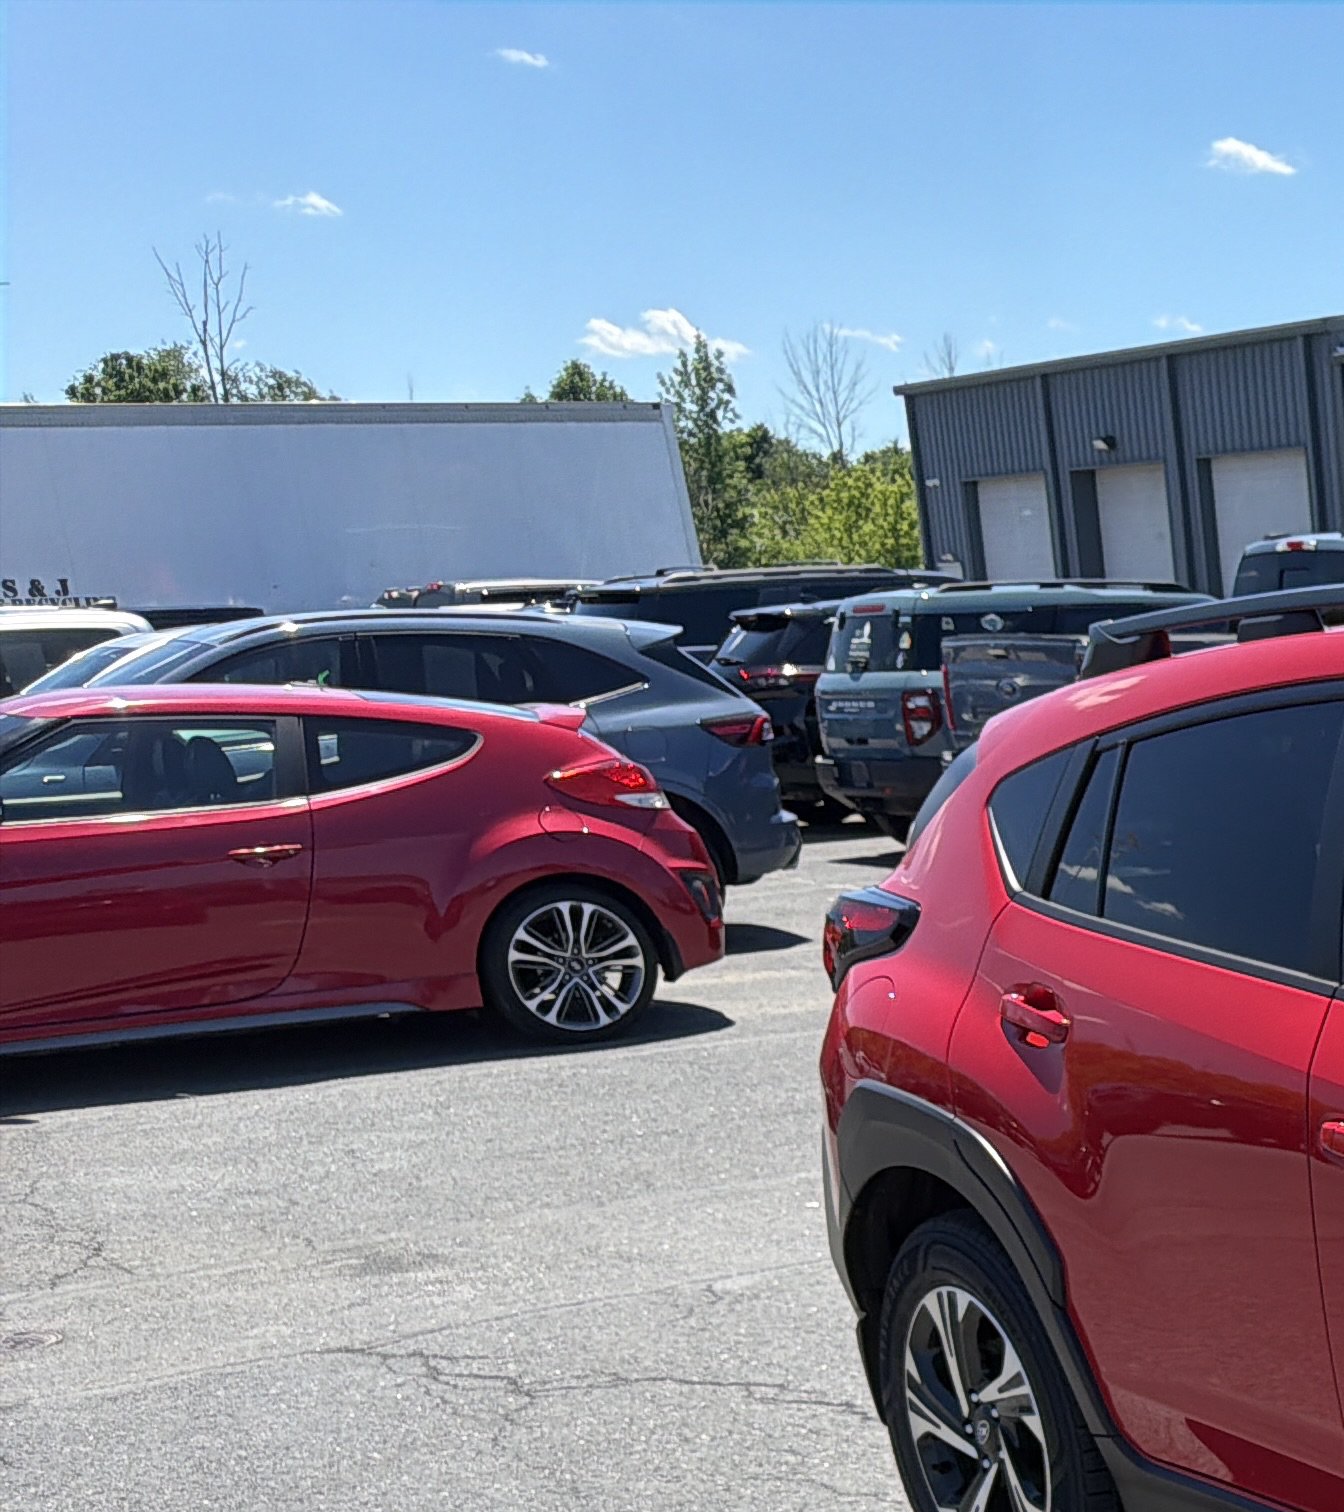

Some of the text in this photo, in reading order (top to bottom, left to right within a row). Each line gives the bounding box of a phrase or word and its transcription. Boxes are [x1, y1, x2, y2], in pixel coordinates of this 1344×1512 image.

[2, 579, 69, 598] S & J
